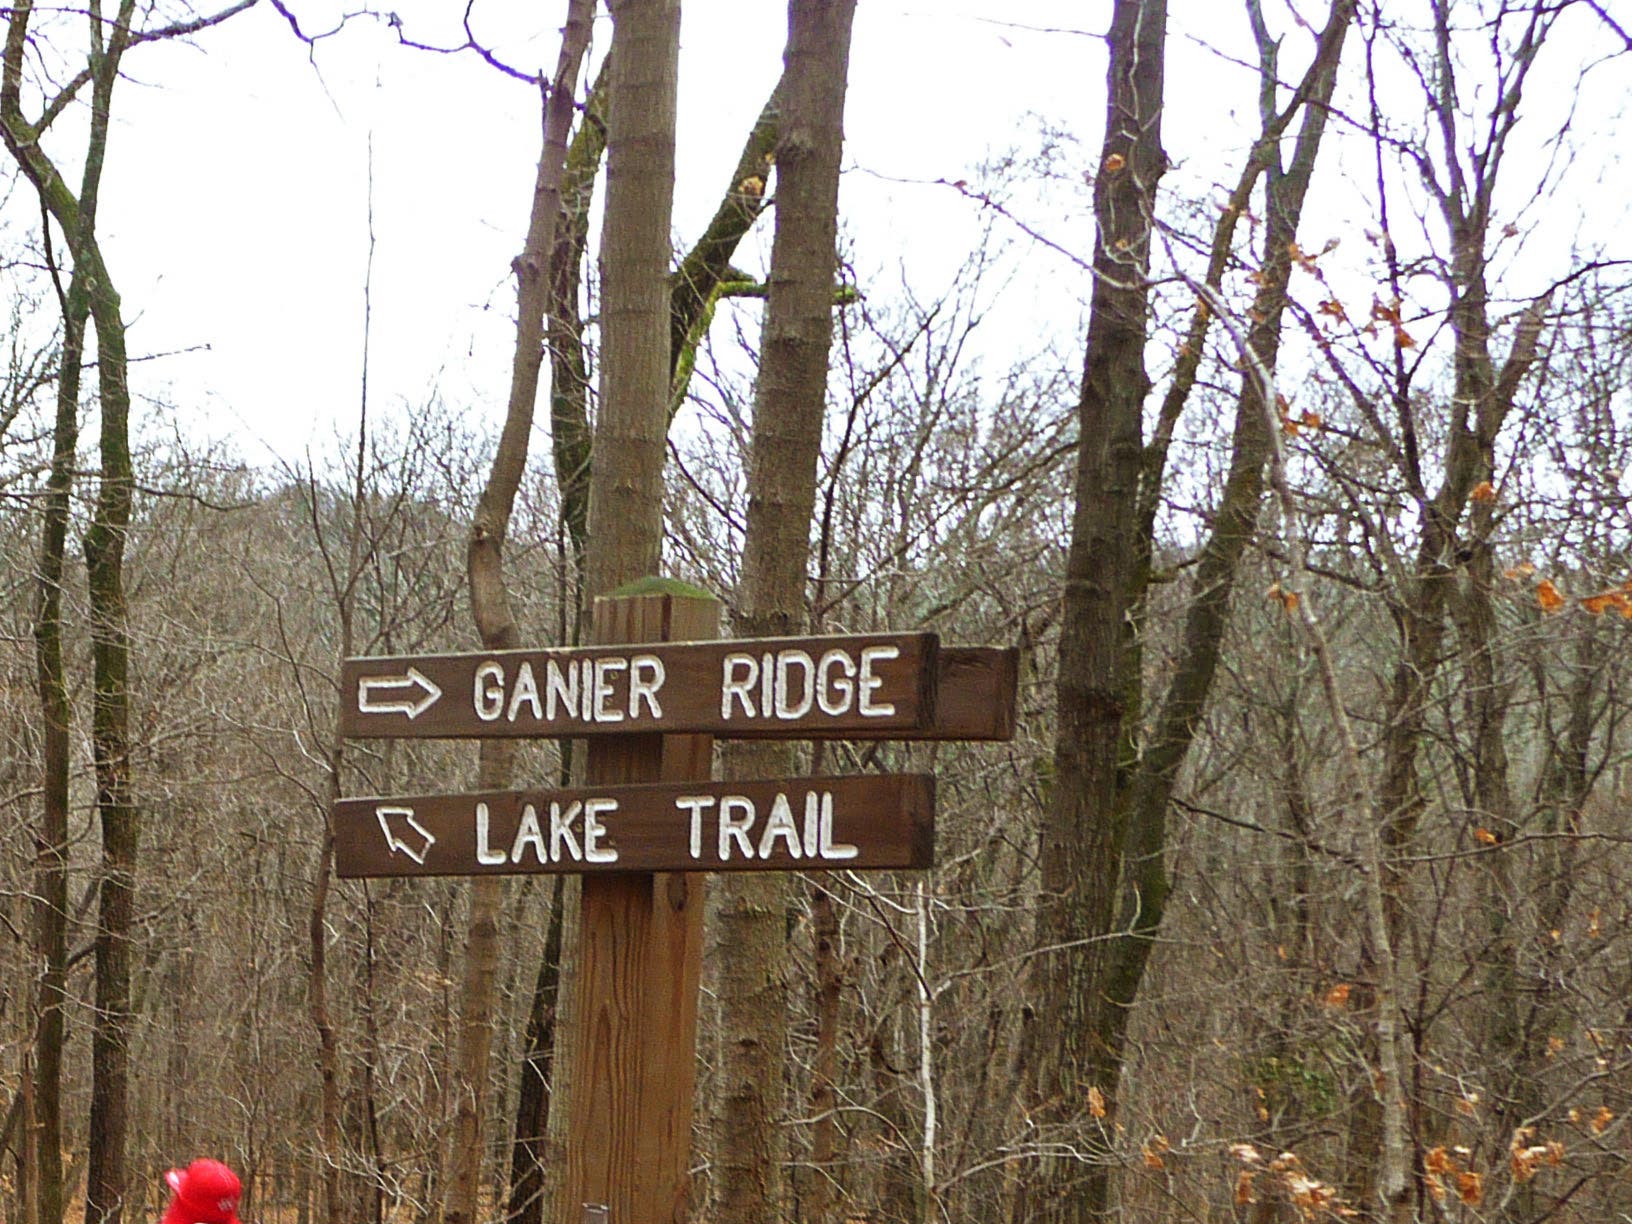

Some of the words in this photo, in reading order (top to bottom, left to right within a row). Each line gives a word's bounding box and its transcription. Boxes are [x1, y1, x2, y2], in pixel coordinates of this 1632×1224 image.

[473, 656, 665, 722] GANIER
[722, 646, 900, 720] RIDGE
[476, 799, 620, 865] LAKE
[676, 792, 859, 861] TRAIL
